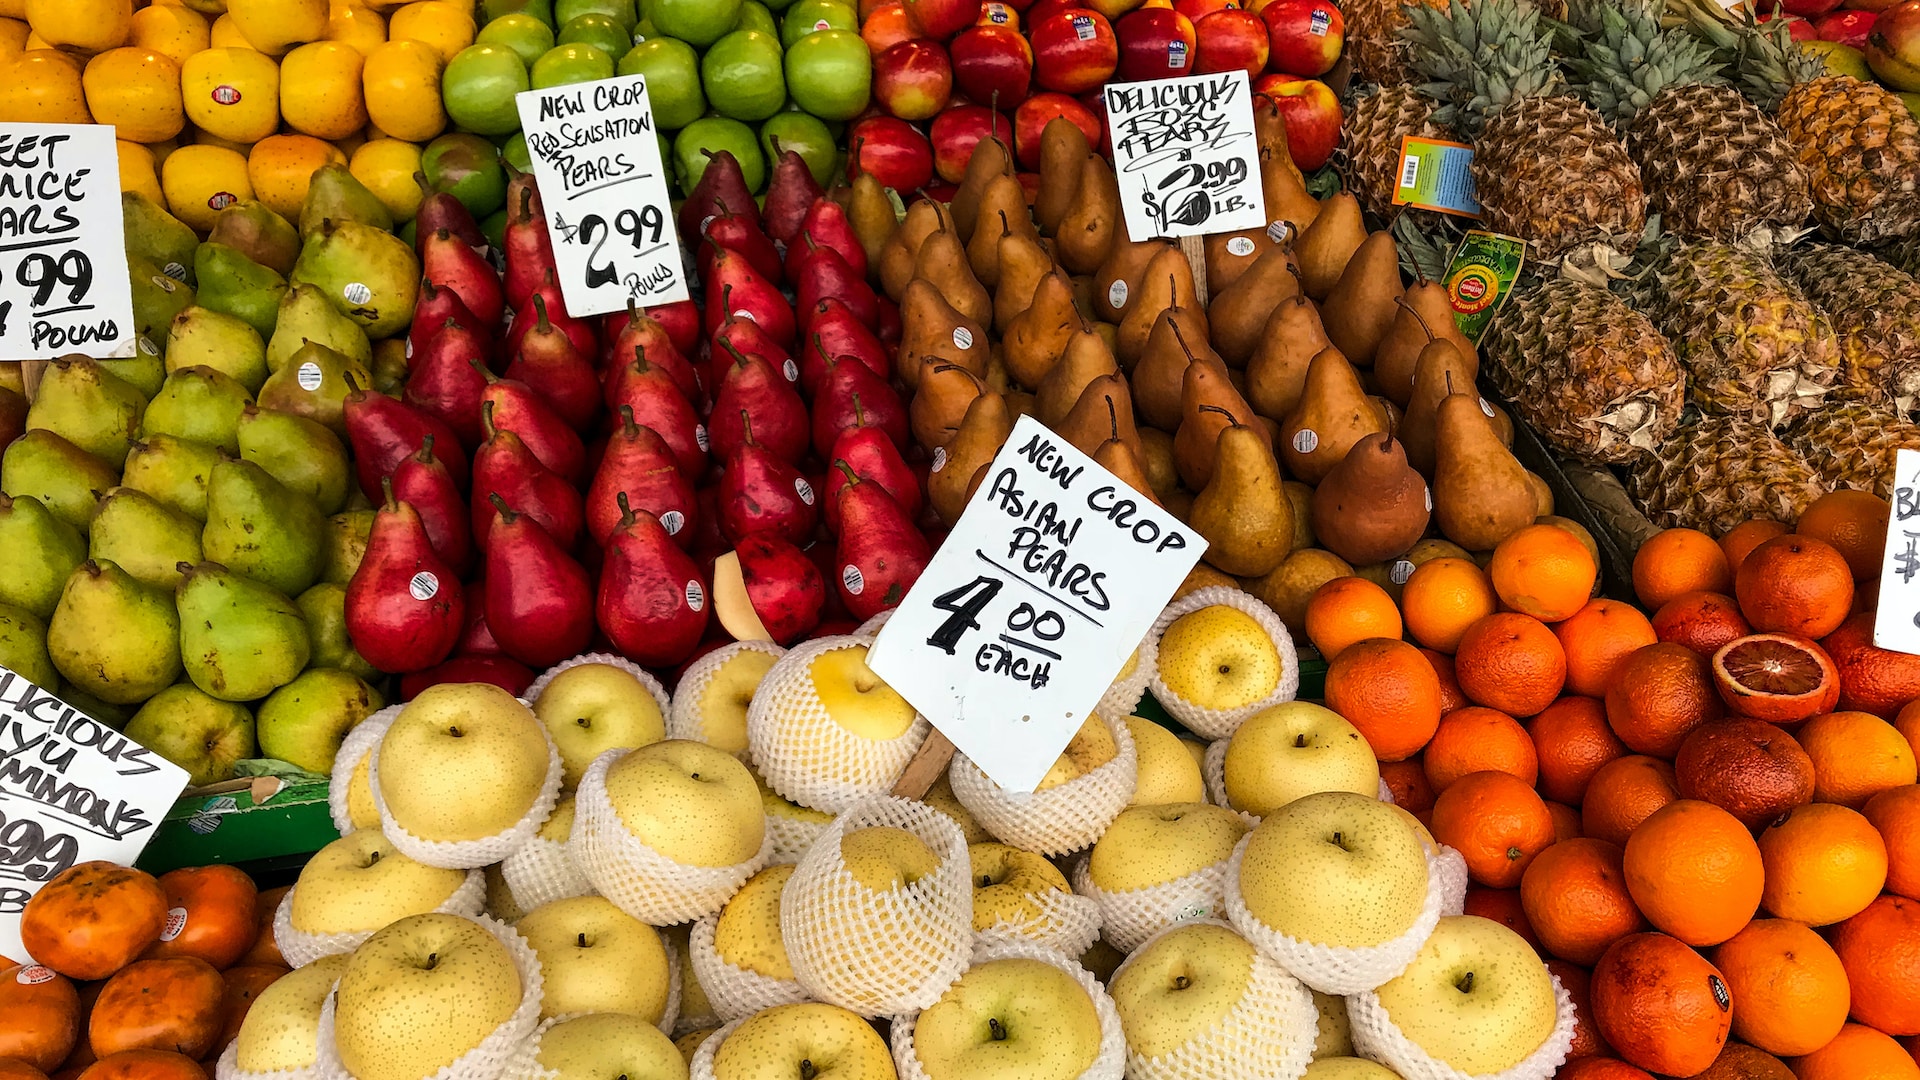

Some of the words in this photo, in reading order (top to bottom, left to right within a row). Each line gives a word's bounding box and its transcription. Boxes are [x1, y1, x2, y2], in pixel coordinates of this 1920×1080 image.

[539, 91, 585, 122] NEW
[594, 81, 644, 112] CROP
[1107, 75, 1241, 114] DELICIOUS
[528, 131, 560, 160] RED
[558, 111, 651, 149] SENSATION
[553, 153, 636, 191] PEARS
[1214, 195, 1255, 215] LB.
[622, 262, 673, 299] POUND
[31, 319, 119, 350] POUND
[988, 467, 1083, 546] ASIAN
[1017, 434, 1084, 490] NEW
[1087, 486, 1187, 553] CROP
[1008, 527, 1110, 611] PEARS
[975, 643, 1052, 690] EACH
[0, 750, 153, 839] MMONS
